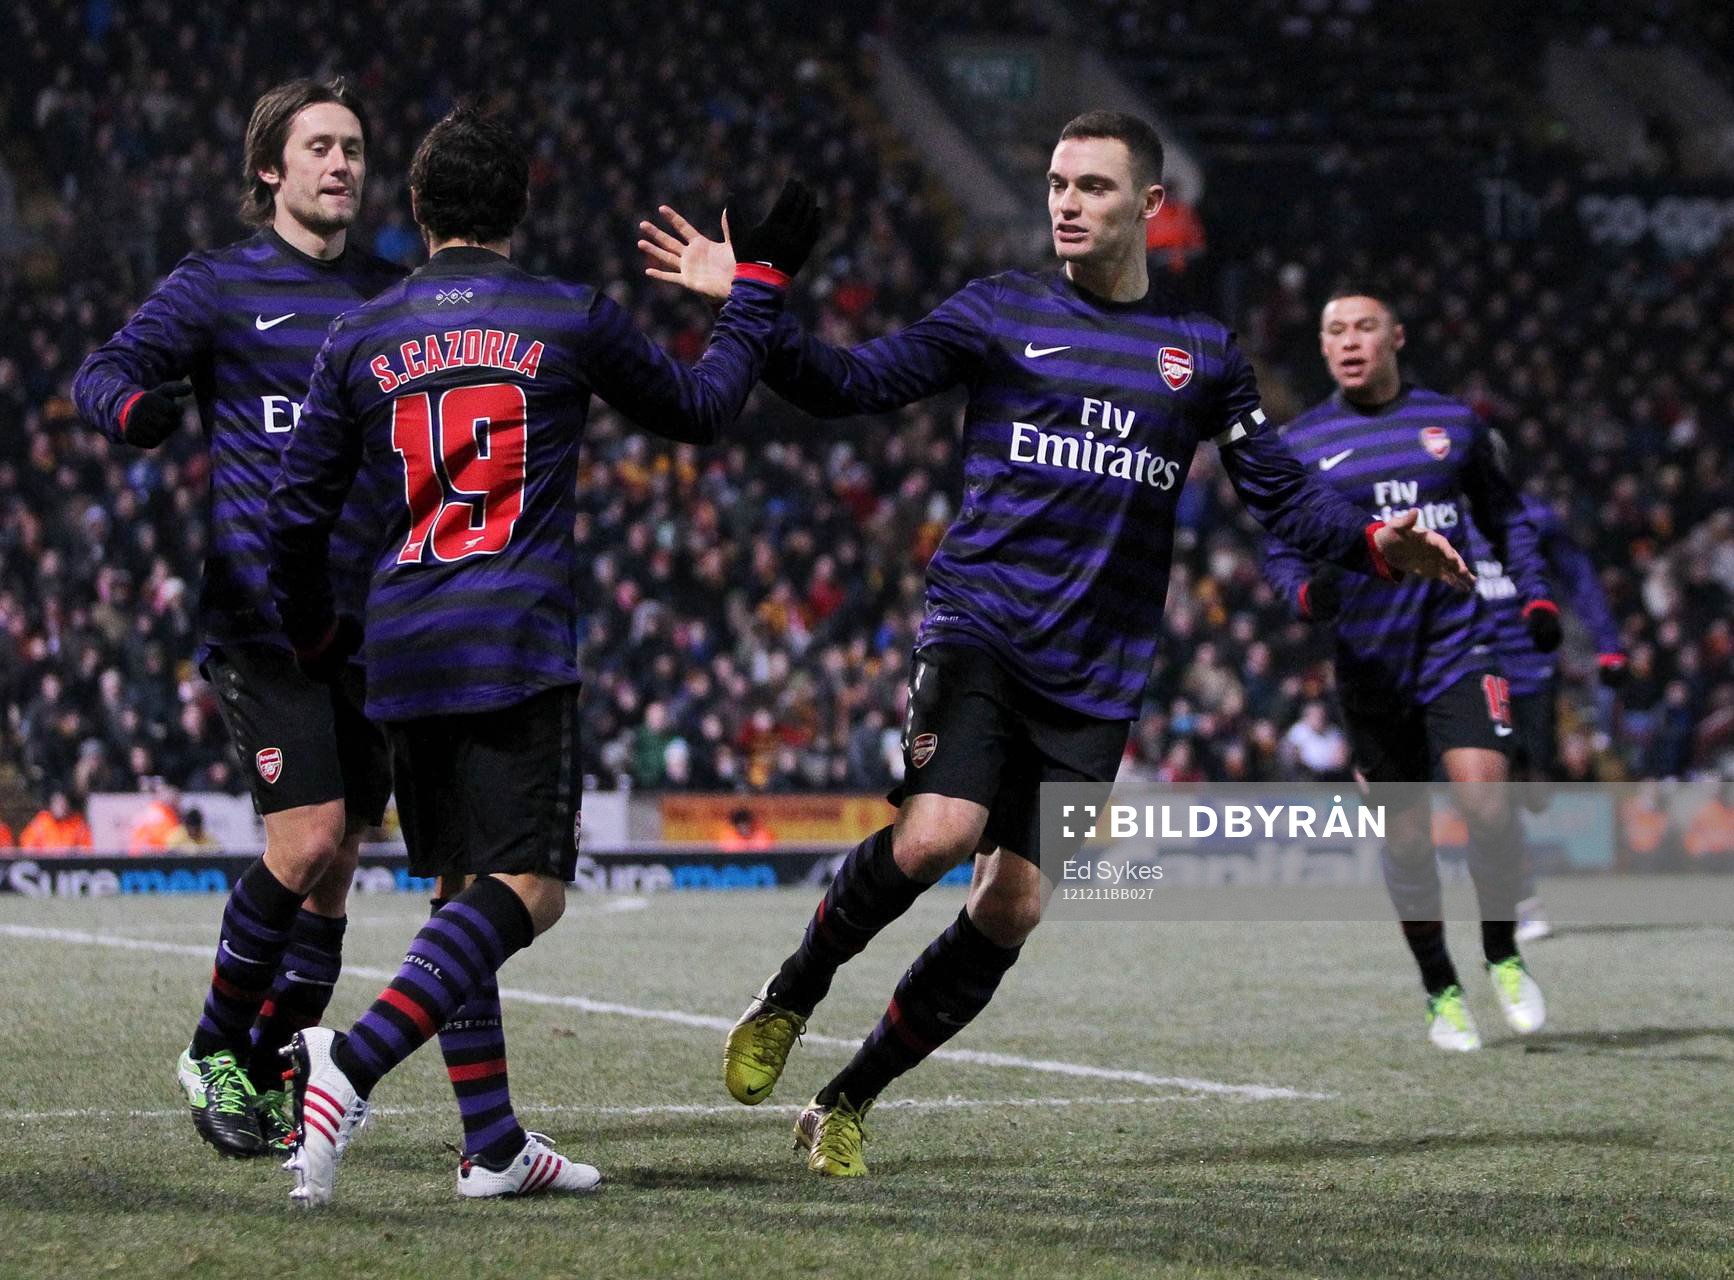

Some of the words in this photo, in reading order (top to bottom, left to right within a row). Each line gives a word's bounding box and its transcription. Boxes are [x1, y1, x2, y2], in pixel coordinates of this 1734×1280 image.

[370, 329, 545, 393] S.CAZORLA
[1080, 397, 1136, 439] Fly
[391, 383, 528, 563] 19
[1010, 421, 1180, 491] Emirates
[1373, 479, 1419, 506] Fly
